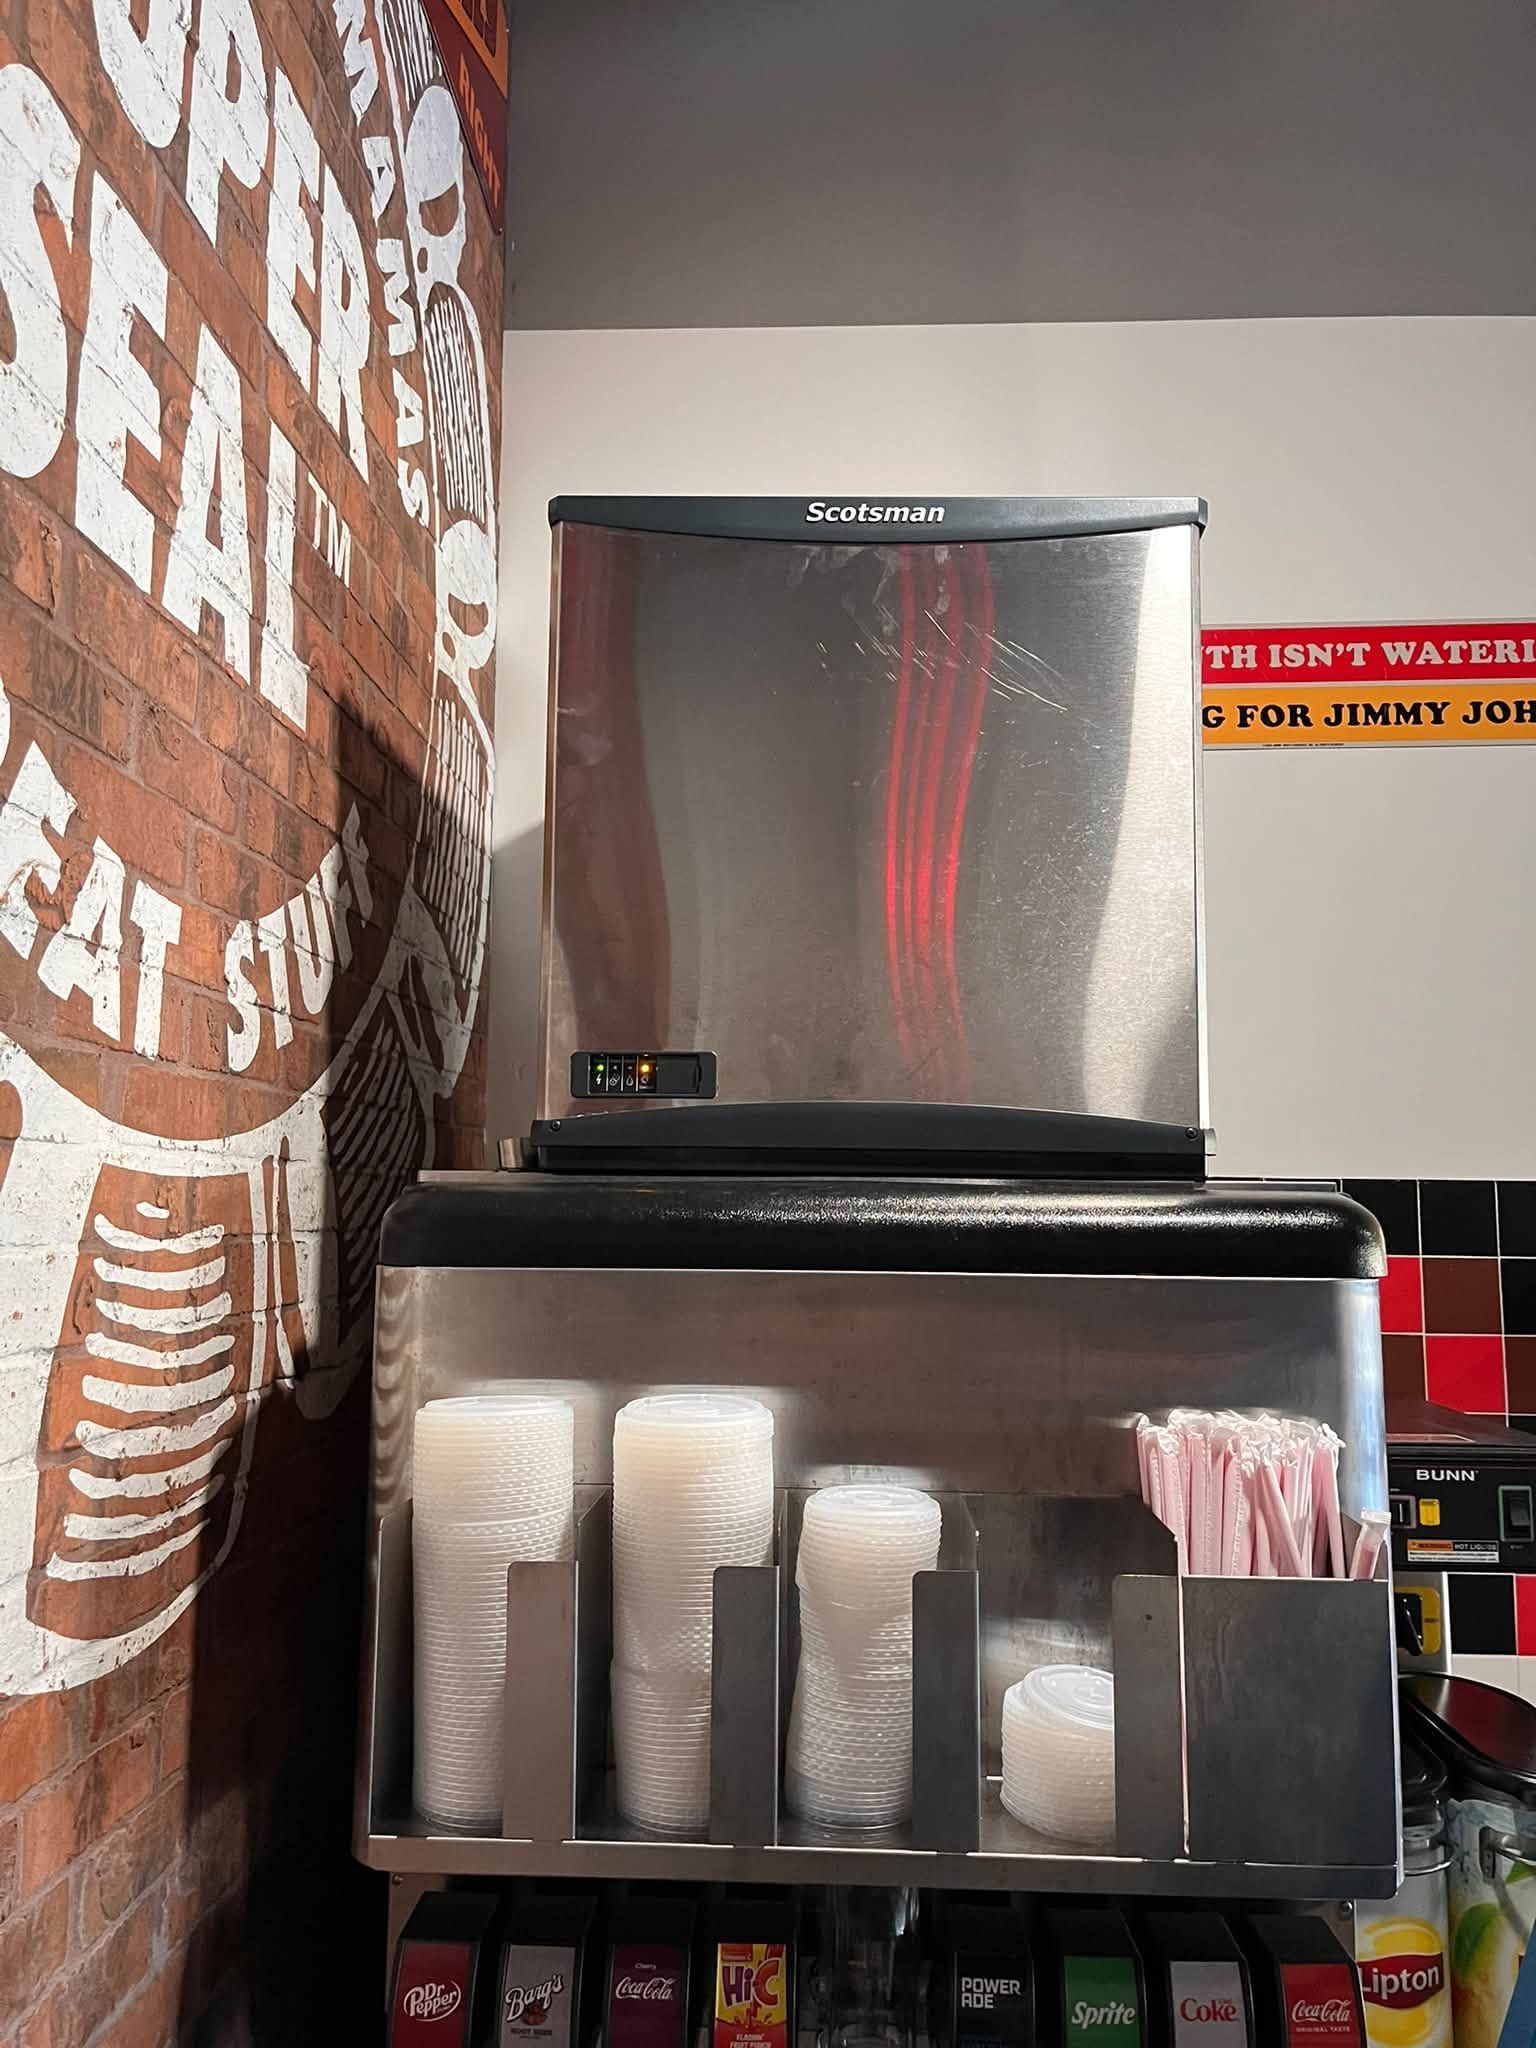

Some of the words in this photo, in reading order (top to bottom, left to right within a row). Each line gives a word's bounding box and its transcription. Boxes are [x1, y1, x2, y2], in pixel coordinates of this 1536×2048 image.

[805, 502, 945, 523] Scotsman
[1201, 645, 1258, 668] TH
[1268, 642, 1371, 667] ISN'T
[1236, 704, 1313, 728] FOR
[1324, 701, 1452, 727] JIMMY
[1462, 700, 1536, 724] JOH
[0, 676, 182, 1060] EAT
[225, 802, 374, 1074] STUFF
[1416, 1469, 1475, 1482] BUNN
[425, 1982, 446, 2001] Dr
[960, 1976, 1022, 1995] POWER
[1359, 1964, 1440, 2001] Lipton
[408, 1986, 458, 2018] Pepper
[504, 1974, 565, 2023] Barq's
[960, 1993, 995, 2009] ADE
[1180, 1997, 1239, 2023] Coke
[1072, 2001, 1137, 2030] Sprite
